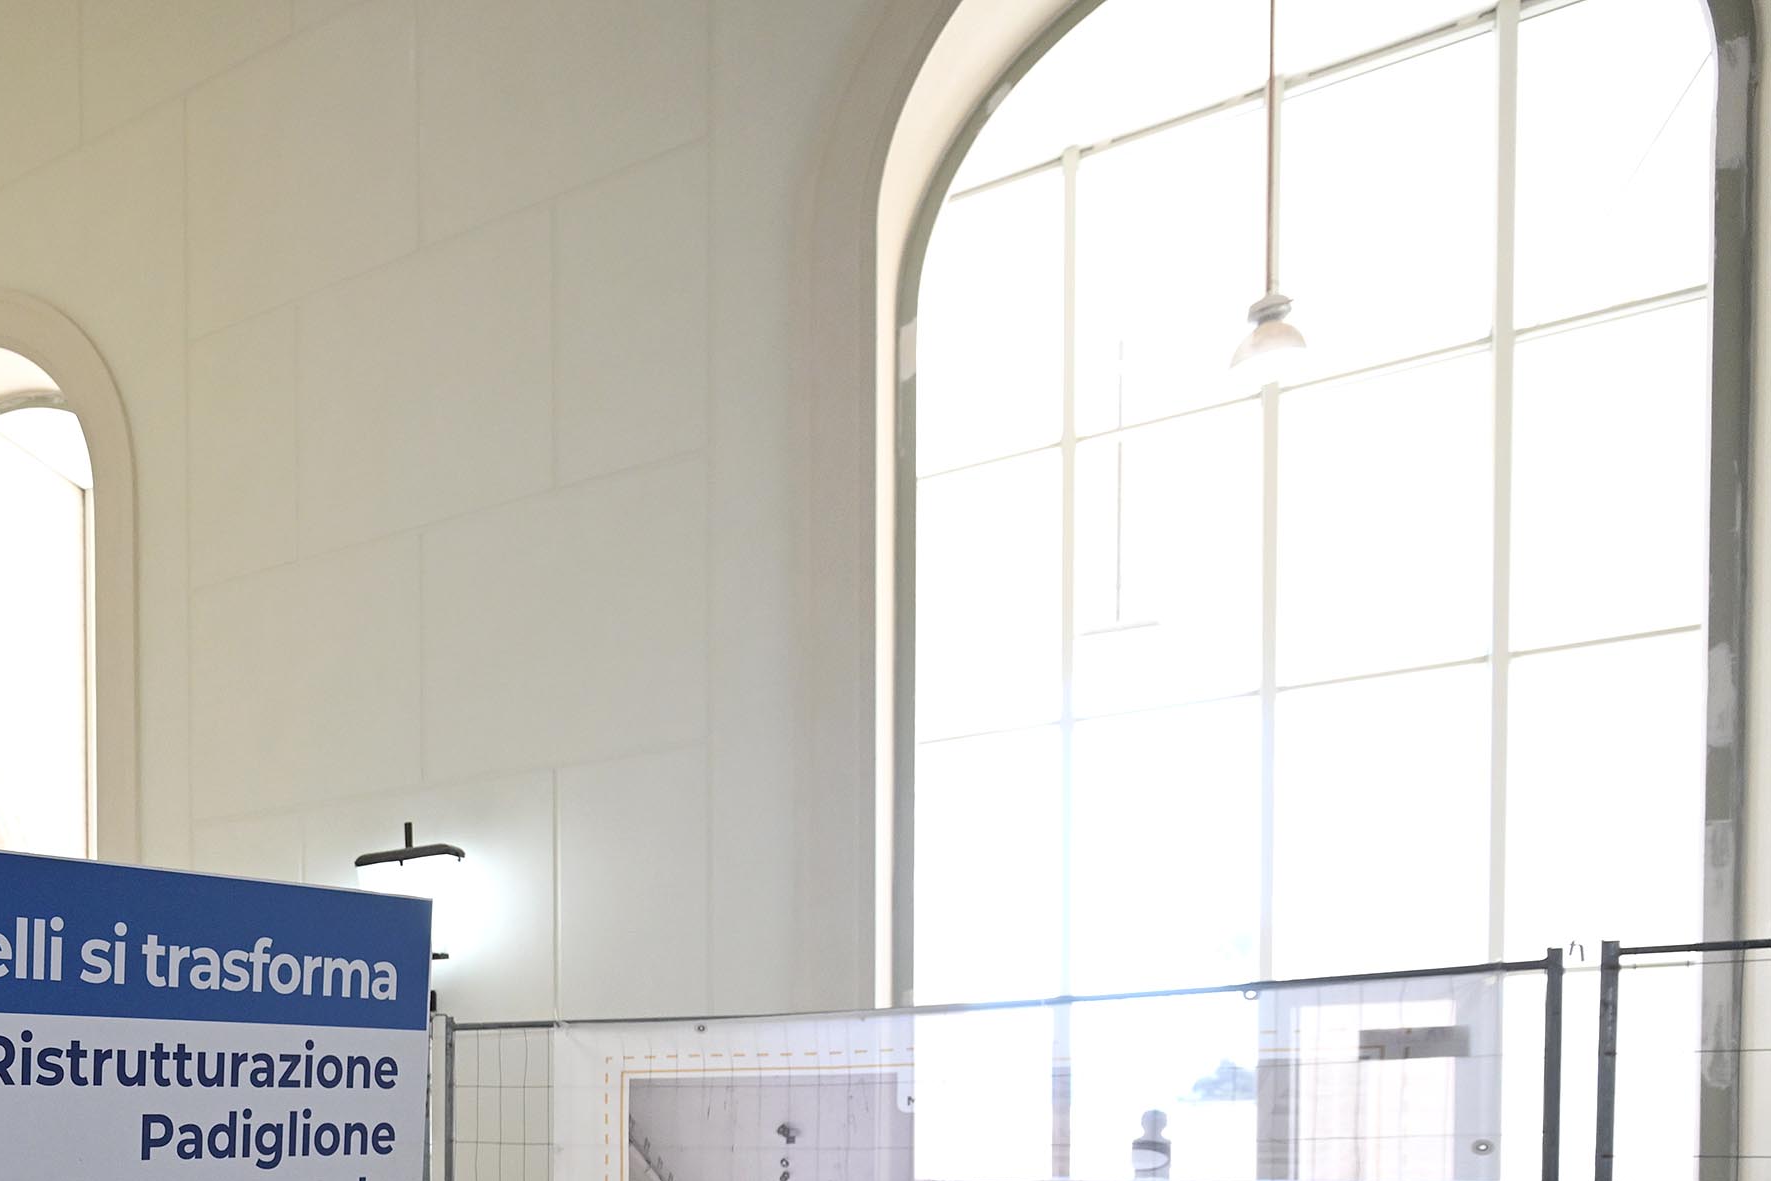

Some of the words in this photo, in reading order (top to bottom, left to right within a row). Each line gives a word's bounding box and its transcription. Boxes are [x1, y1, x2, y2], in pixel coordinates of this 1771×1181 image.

[80, 922, 127, 985] si
[142, 933, 397, 1001] trasforma
[140, 1110, 396, 1170] Padiglione
